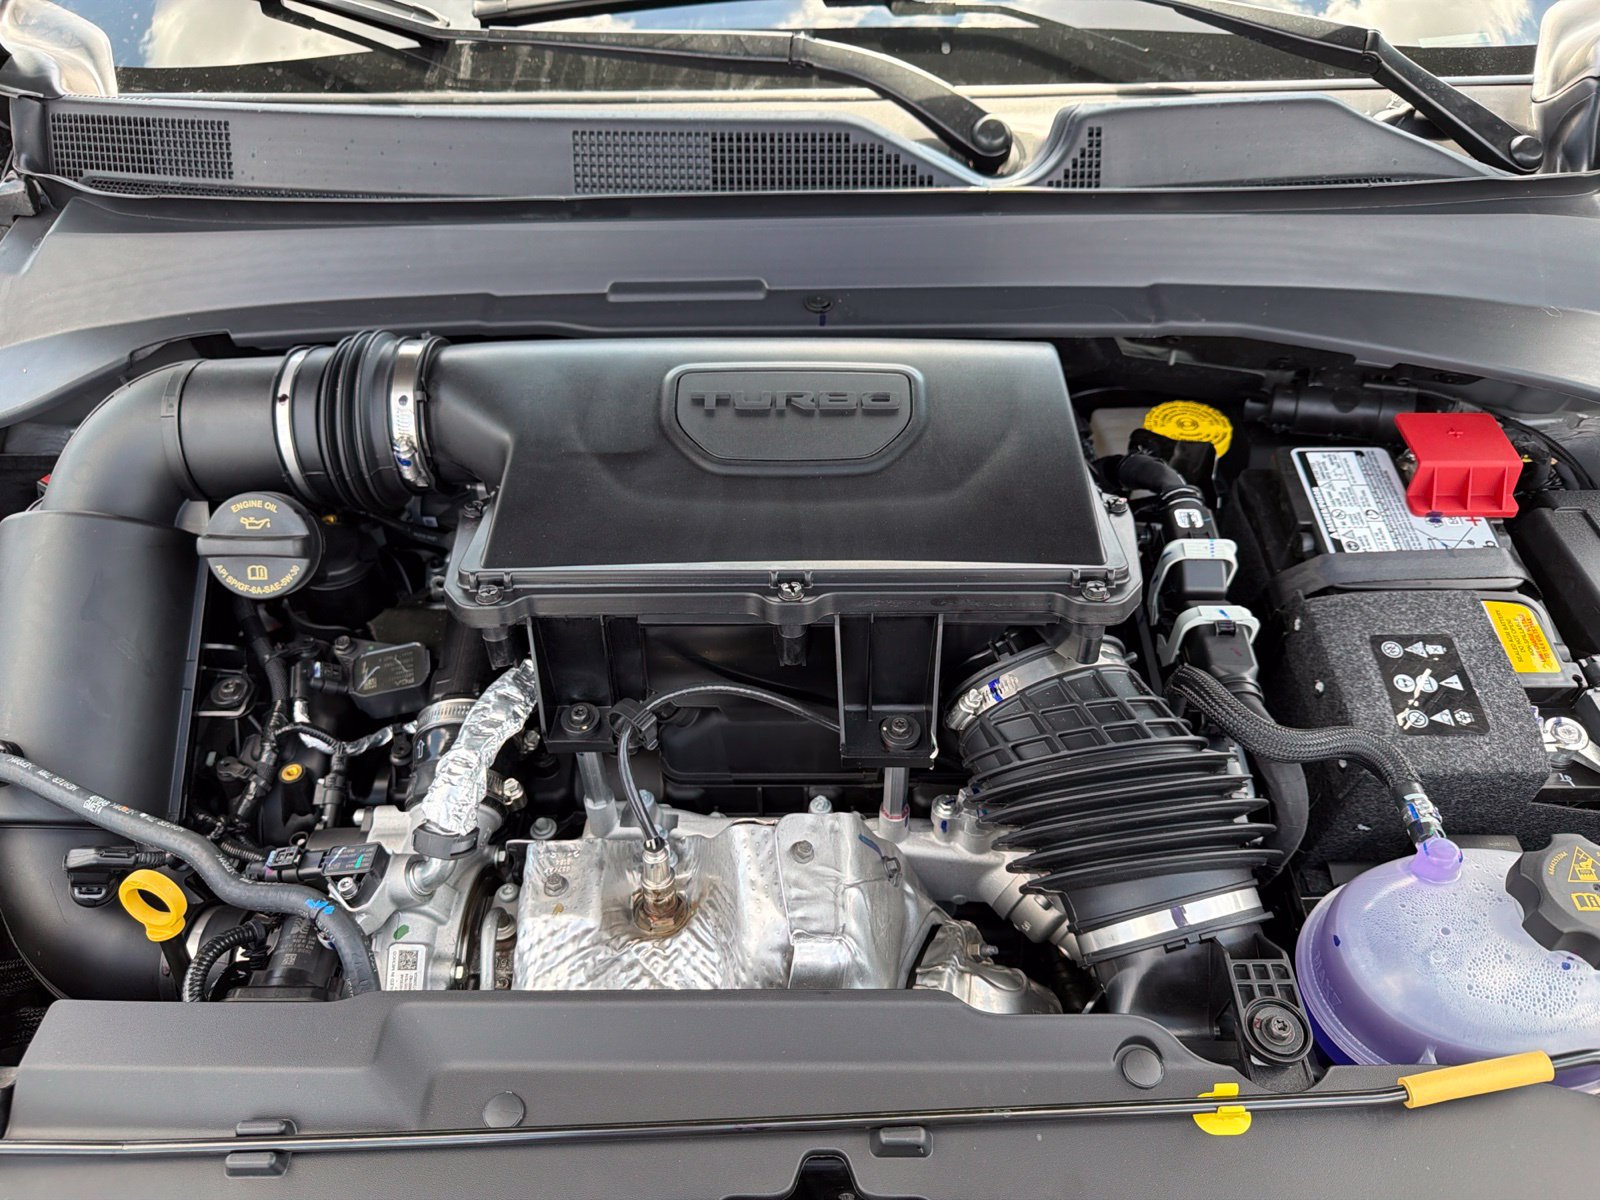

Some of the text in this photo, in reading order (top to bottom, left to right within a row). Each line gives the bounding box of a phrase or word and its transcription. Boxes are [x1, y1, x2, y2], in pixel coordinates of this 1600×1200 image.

[690, 390, 900, 412] TURBO
[230, 500, 278, 513] ENGINE OIL
[215, 564, 228, 578] API
